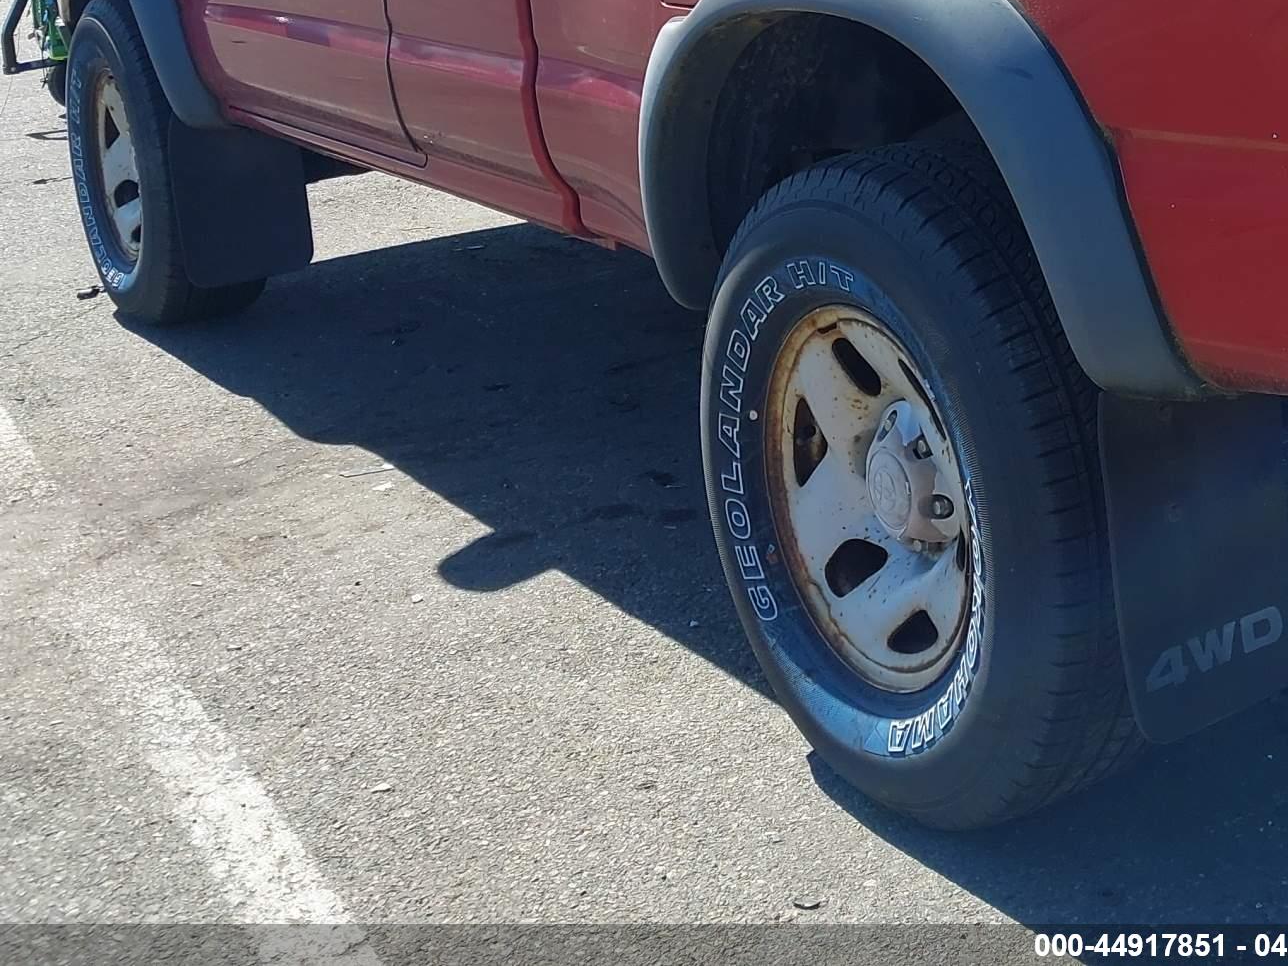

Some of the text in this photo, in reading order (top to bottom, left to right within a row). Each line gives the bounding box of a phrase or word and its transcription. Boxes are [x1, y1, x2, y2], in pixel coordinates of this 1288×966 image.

[718, 276, 785, 621] GEOLANDAR
[887, 476, 986, 754] YOKOHAMA
[1145, 605, 1284, 693] 4WD
